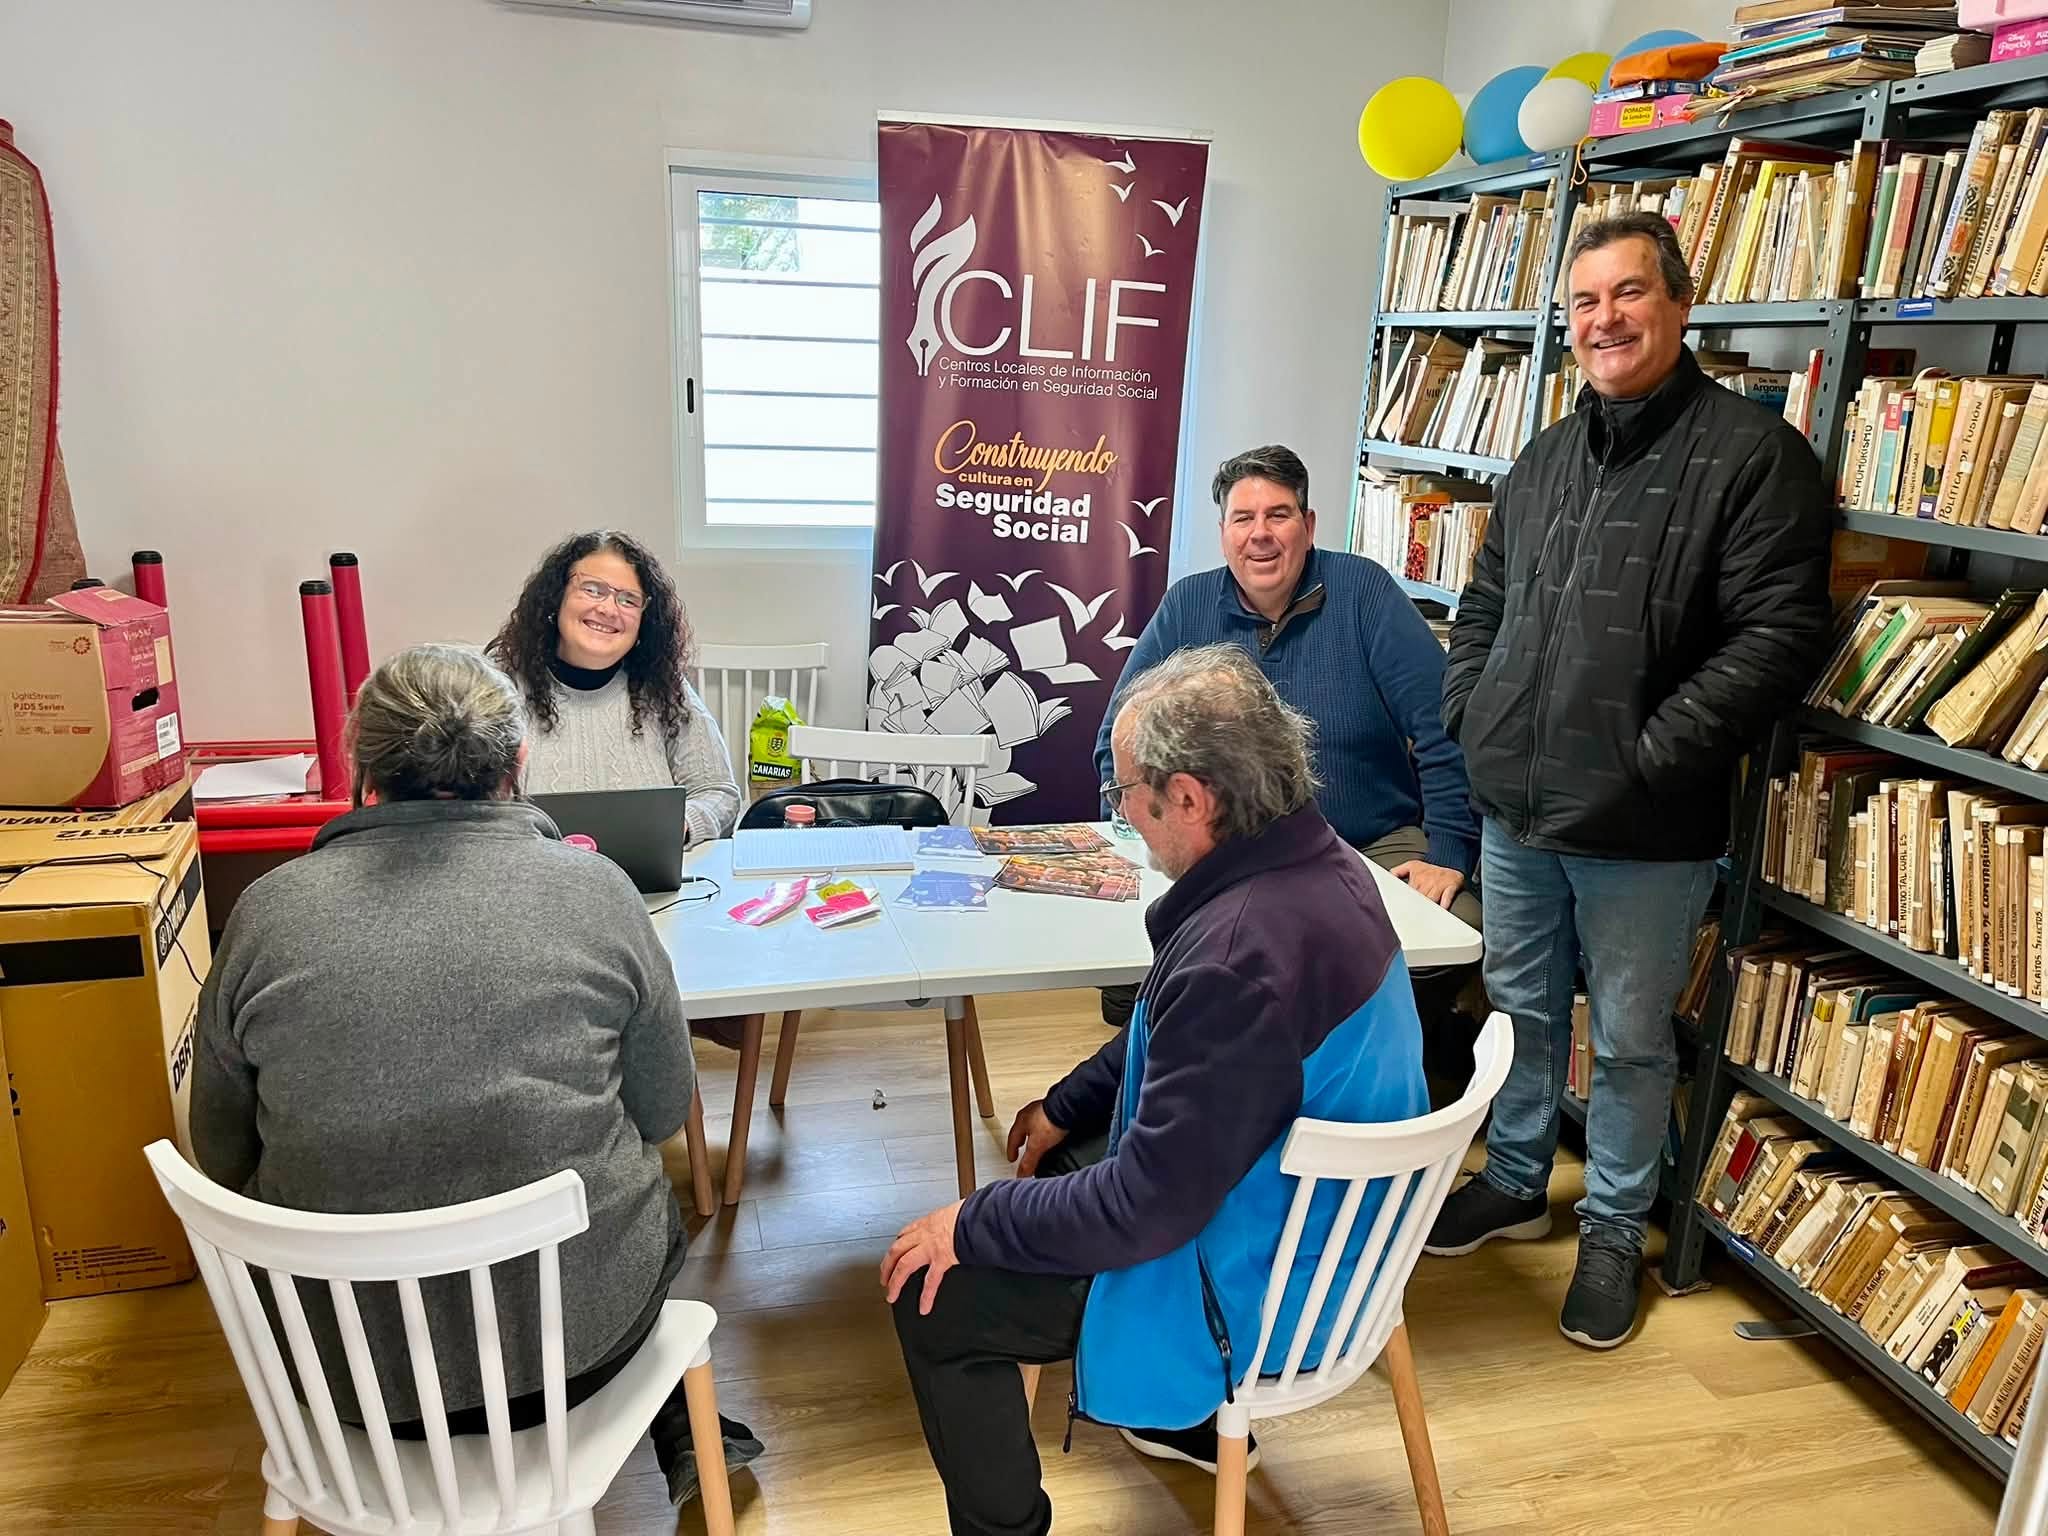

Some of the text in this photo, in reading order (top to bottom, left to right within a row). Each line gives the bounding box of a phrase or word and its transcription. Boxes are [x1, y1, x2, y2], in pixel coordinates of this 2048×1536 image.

[941, 271, 1166, 361] CLIF
[939, 357, 1151, 382] Centros Locales de Información
[938, 374, 1158, 399] y Formación en Seguridad Social
[935, 420, 1118, 492] Construyendo
[1958, 448, 1968, 462] DE
[958, 471, 1033, 487] cultura en
[935, 483, 1091, 518] Seguridad
[1850, 489, 1860, 505] EL
[992, 513, 1089, 543] Social
[38, 703, 65, 711] Series
[753, 764, 791, 778] CANARIAS
[56, 824, 175, 839] DBR12
[1899, 833, 1906, 845] ES
[1899, 890, 1907, 920] MUNDO
[1981, 911, 1991, 927] DE
[1899, 925, 1906, 933] EL
[2032, 911, 2043, 950] SELECTOS
[1859, 1291, 1868, 1300] DE
[2015, 1322, 2044, 1364] DESARROLLO
[2011, 1363, 2023, 1373] DE
[1995, 1373, 2018, 1405] NACIONAL
